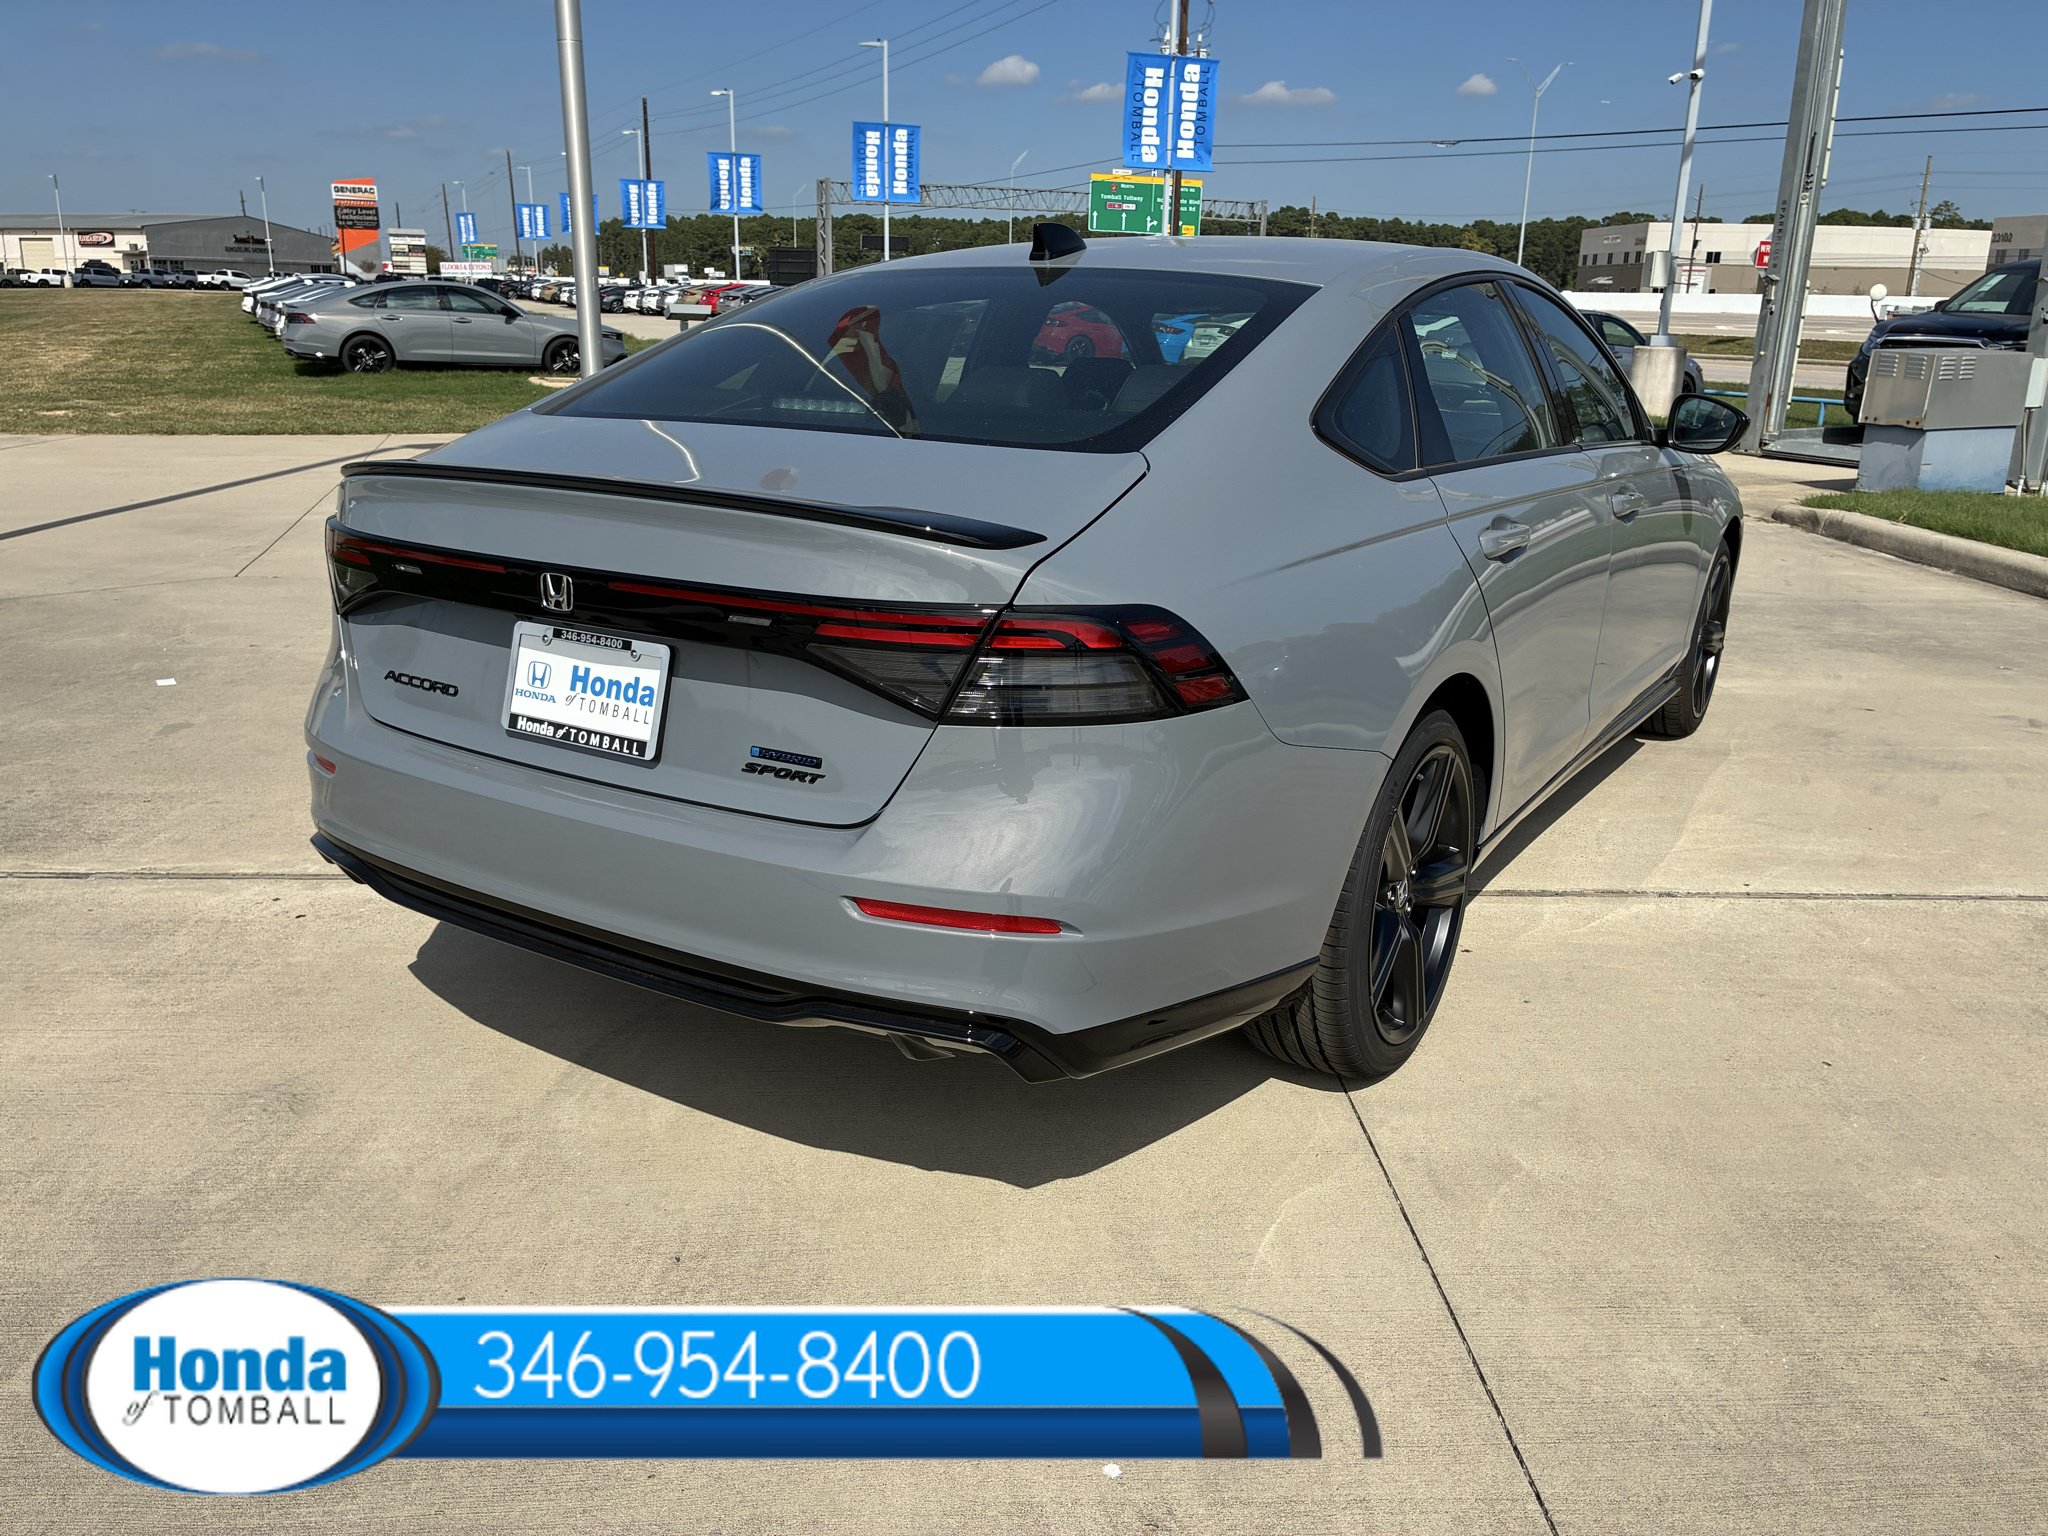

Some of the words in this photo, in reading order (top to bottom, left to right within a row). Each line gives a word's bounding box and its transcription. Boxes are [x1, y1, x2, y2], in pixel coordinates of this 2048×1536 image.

[1130, 80, 1144, 161] TOMBALL
[1141, 67, 1164, 163] Honda
[1176, 63, 1201, 159] Honda
[1195, 66, 1210, 146] TOMBALL
[865, 130, 880, 197] Honda
[893, 128, 908, 195] Honda
[333, 185, 375, 195] GENERAC
[717, 158, 731, 210] Honda
[739, 157, 752, 208] Honda
[1123, 194, 1144, 202] Tollway
[521, 206, 531, 238] Honda
[535, 205, 546, 237] Honda
[628, 184, 640, 226] Honda
[646, 183, 658, 224] Honda
[560, 630, 623, 649] 346-954-8400
[384, 670, 459, 697] ACCORD
[514, 688, 557, 704] HONDA
[569, 664, 655, 708] Honda
[565, 692, 580, 707] of
[579, 697, 650, 725] TOMBALL
[516, 715, 554, 737] Honda
[555, 726, 568, 739] of
[568, 728, 640, 756] TOMBALL
[741, 762, 826, 785] SPORT
[760, 748, 817, 766] HYBRID
